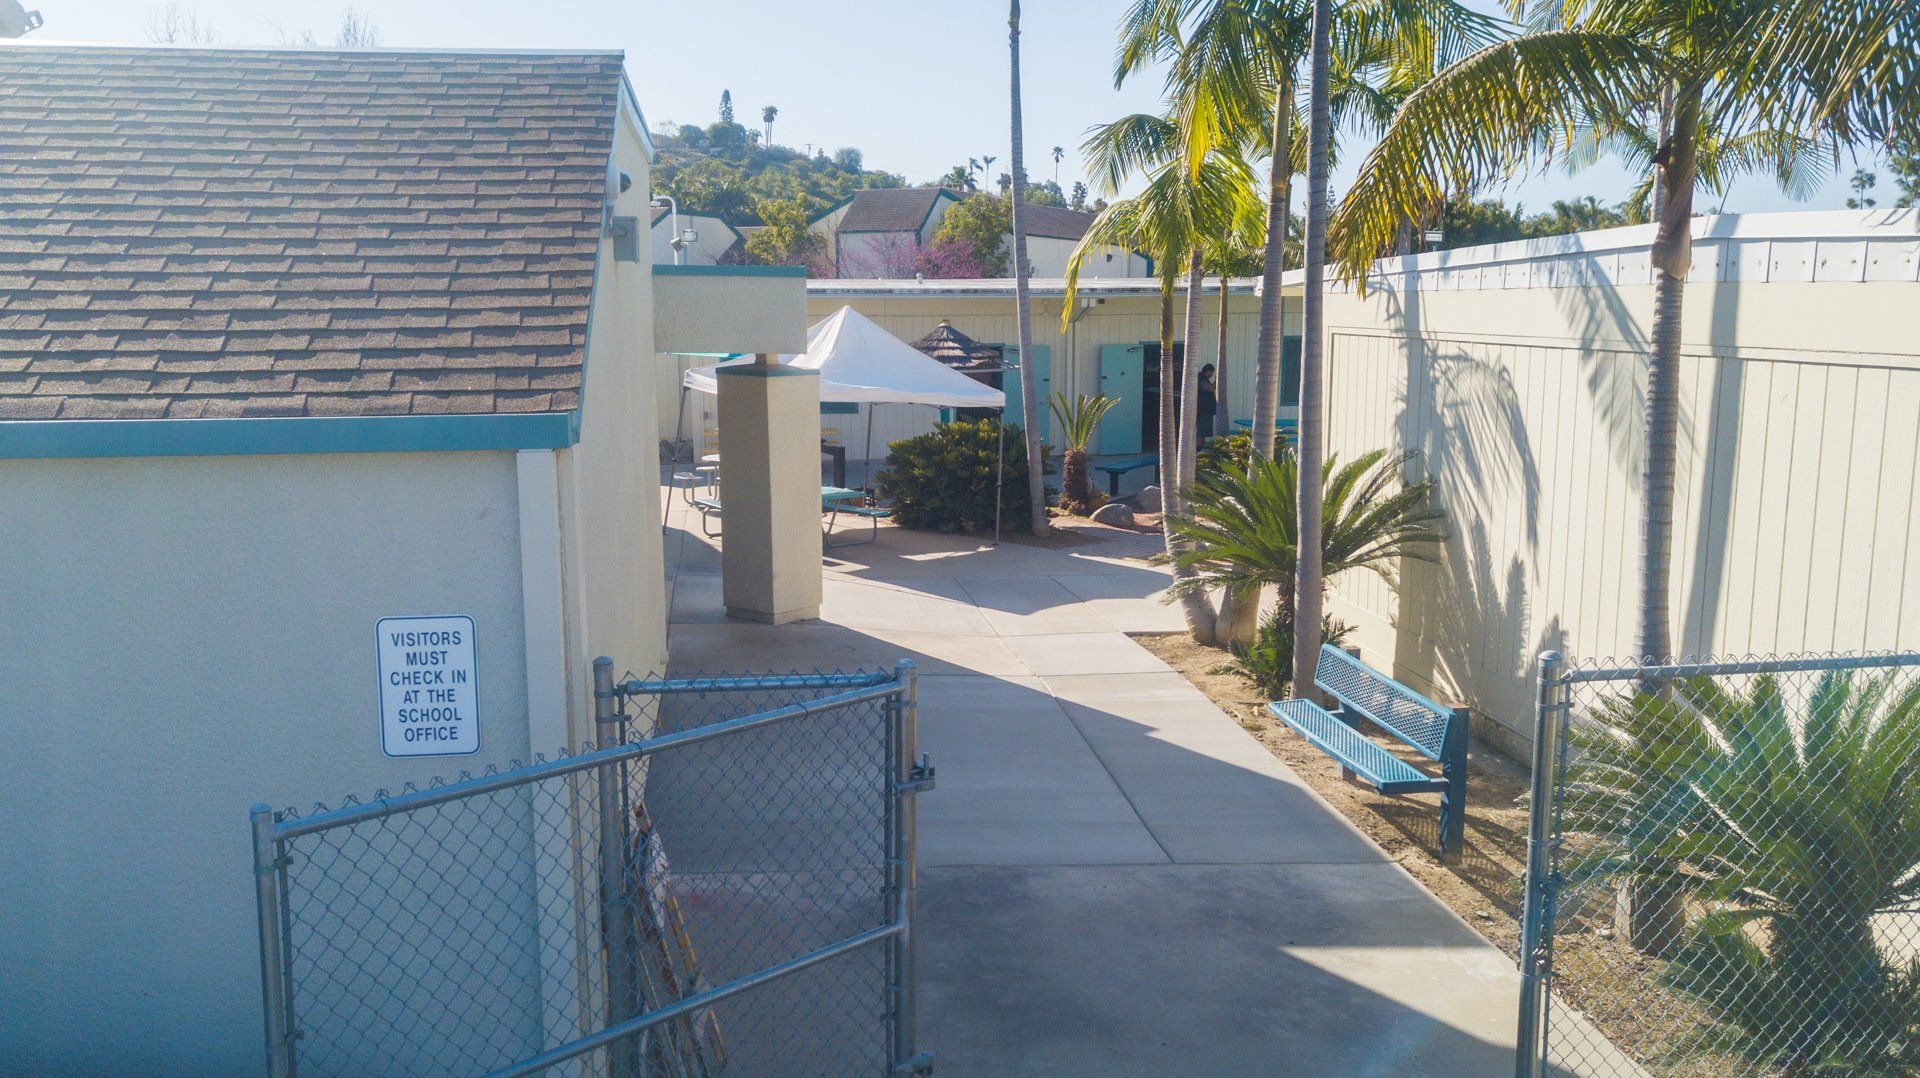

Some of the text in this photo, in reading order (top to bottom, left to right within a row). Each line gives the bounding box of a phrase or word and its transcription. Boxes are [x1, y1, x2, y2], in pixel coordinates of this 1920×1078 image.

[391, 631, 462, 647] VISITORS
[406, 651, 448, 666] MUST
[390, 669, 466, 685] CHECK IN
[403, 689, 456, 704] AT THE
[398, 707, 462, 723] SCHOOL
[404, 726, 458, 742] OFFICE
